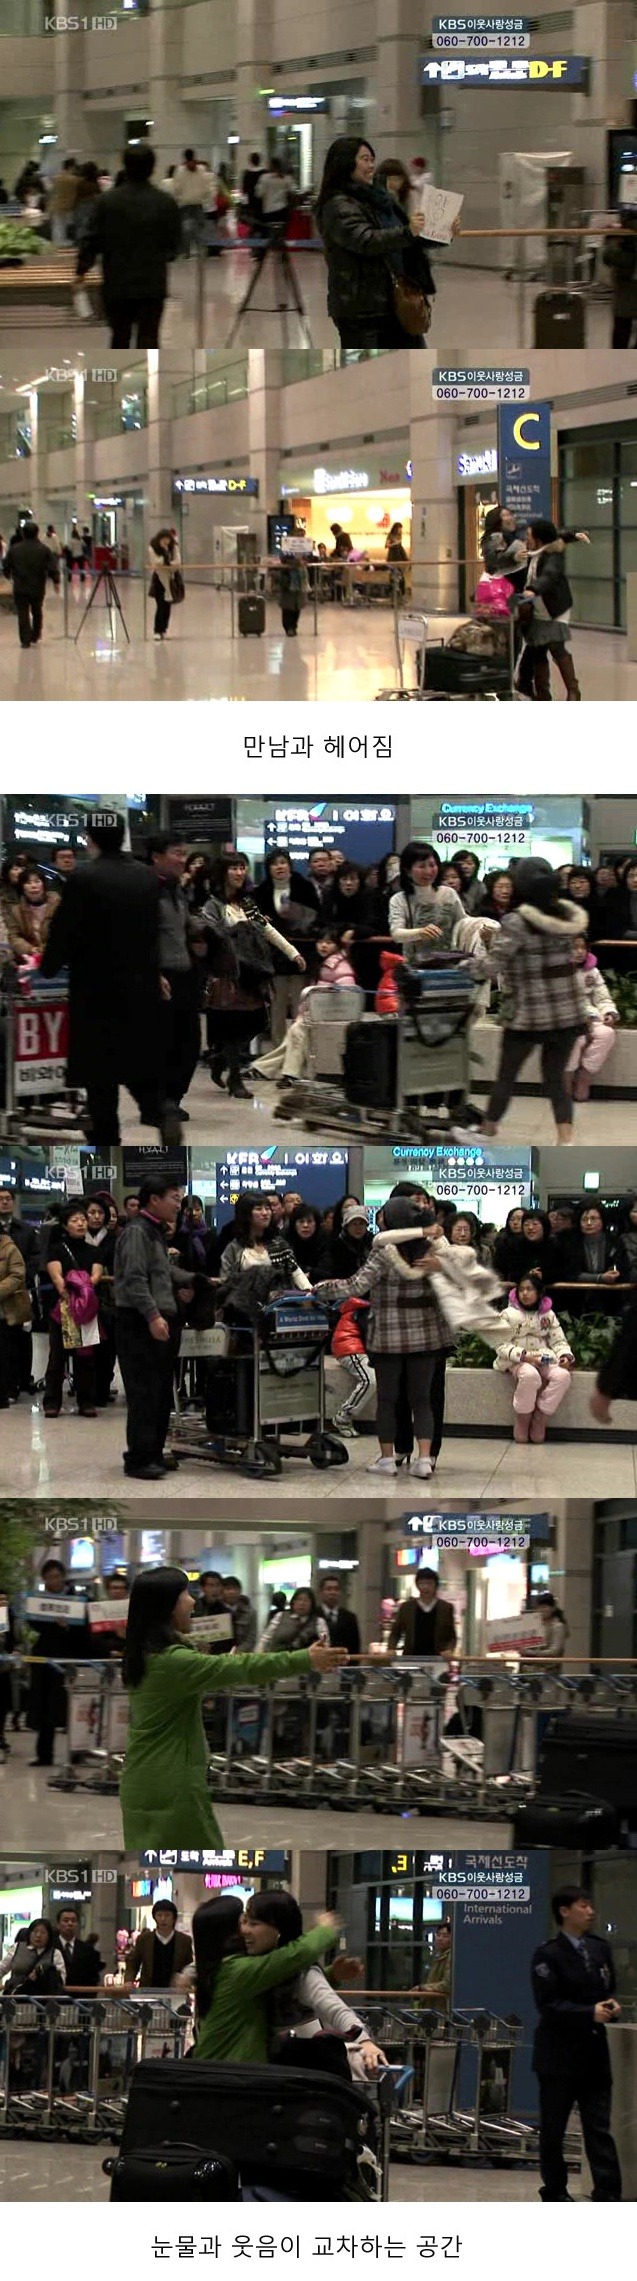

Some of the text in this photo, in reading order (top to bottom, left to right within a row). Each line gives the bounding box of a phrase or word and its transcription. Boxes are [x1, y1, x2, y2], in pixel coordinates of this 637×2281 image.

[513, 412, 540, 450] C
[392, 1147, 482, 1158] Currency Exchange
[466, 1854, 528, 1869] 국제선도착
[464, 1904, 532, 1914] International
[463, 1915, 502, 1924] Arrivals
